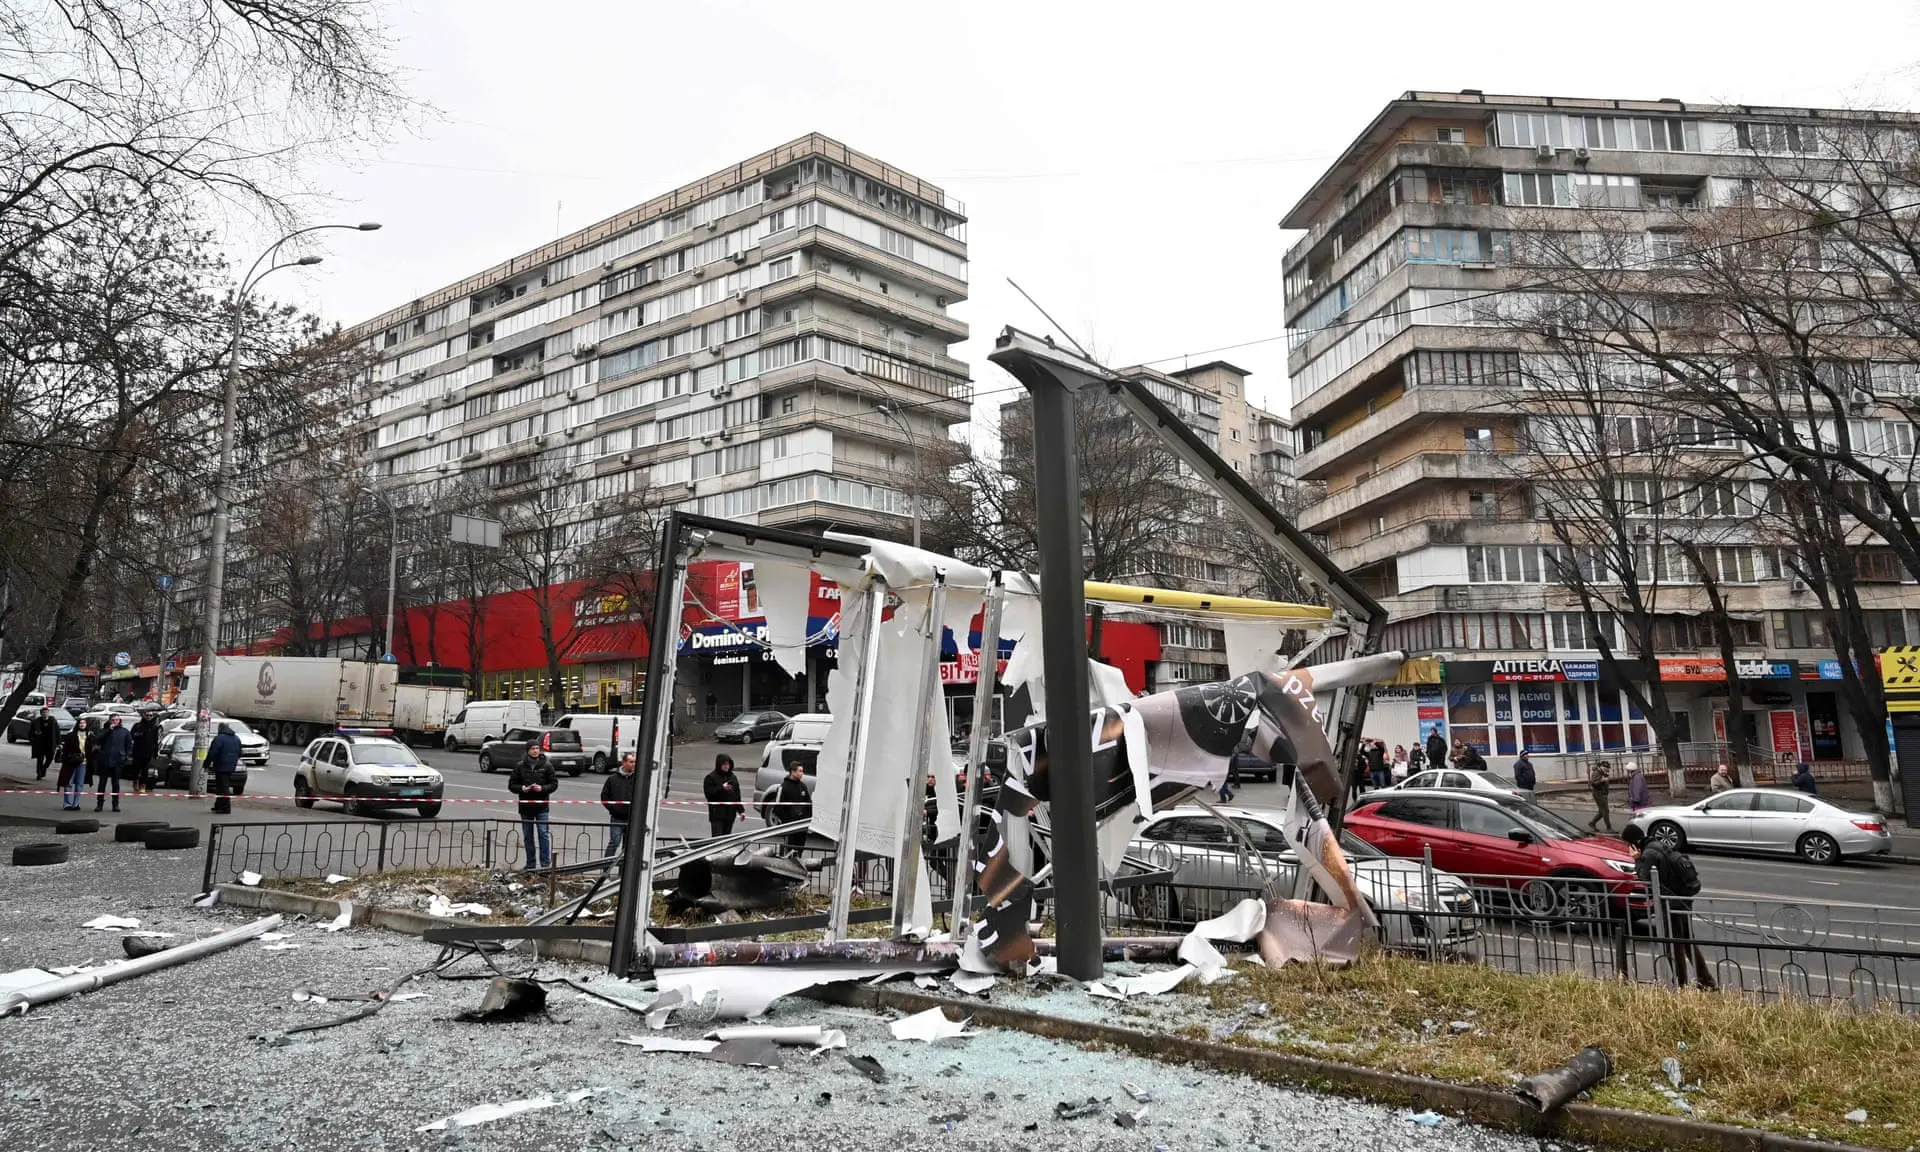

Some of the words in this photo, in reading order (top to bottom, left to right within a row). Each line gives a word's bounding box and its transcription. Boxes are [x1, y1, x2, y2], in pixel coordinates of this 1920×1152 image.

[692, 627, 754, 649] Domino's
[1492, 660, 1561, 673] АПТЕКА
[1375, 688, 1415, 698] ОРЕНДА
